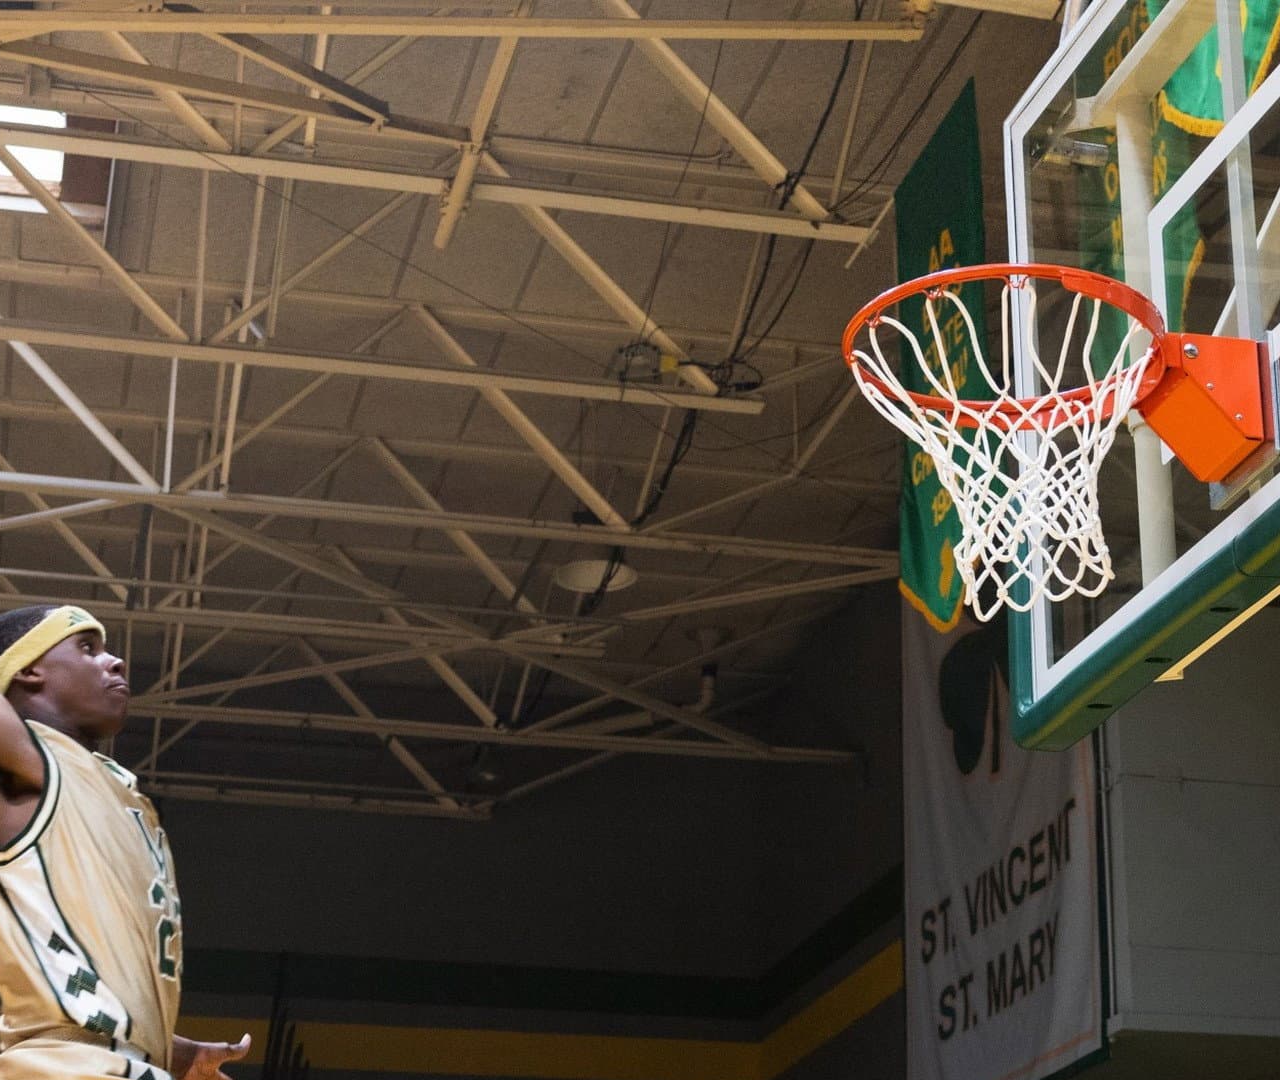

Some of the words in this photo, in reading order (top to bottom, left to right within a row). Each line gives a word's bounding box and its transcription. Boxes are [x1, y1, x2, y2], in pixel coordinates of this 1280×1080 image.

[921, 898, 957, 964] ST.
[963, 798, 1076, 936] VINCENT
[937, 973, 978, 1041] ST.
[986, 911, 1062, 1018] MARY
